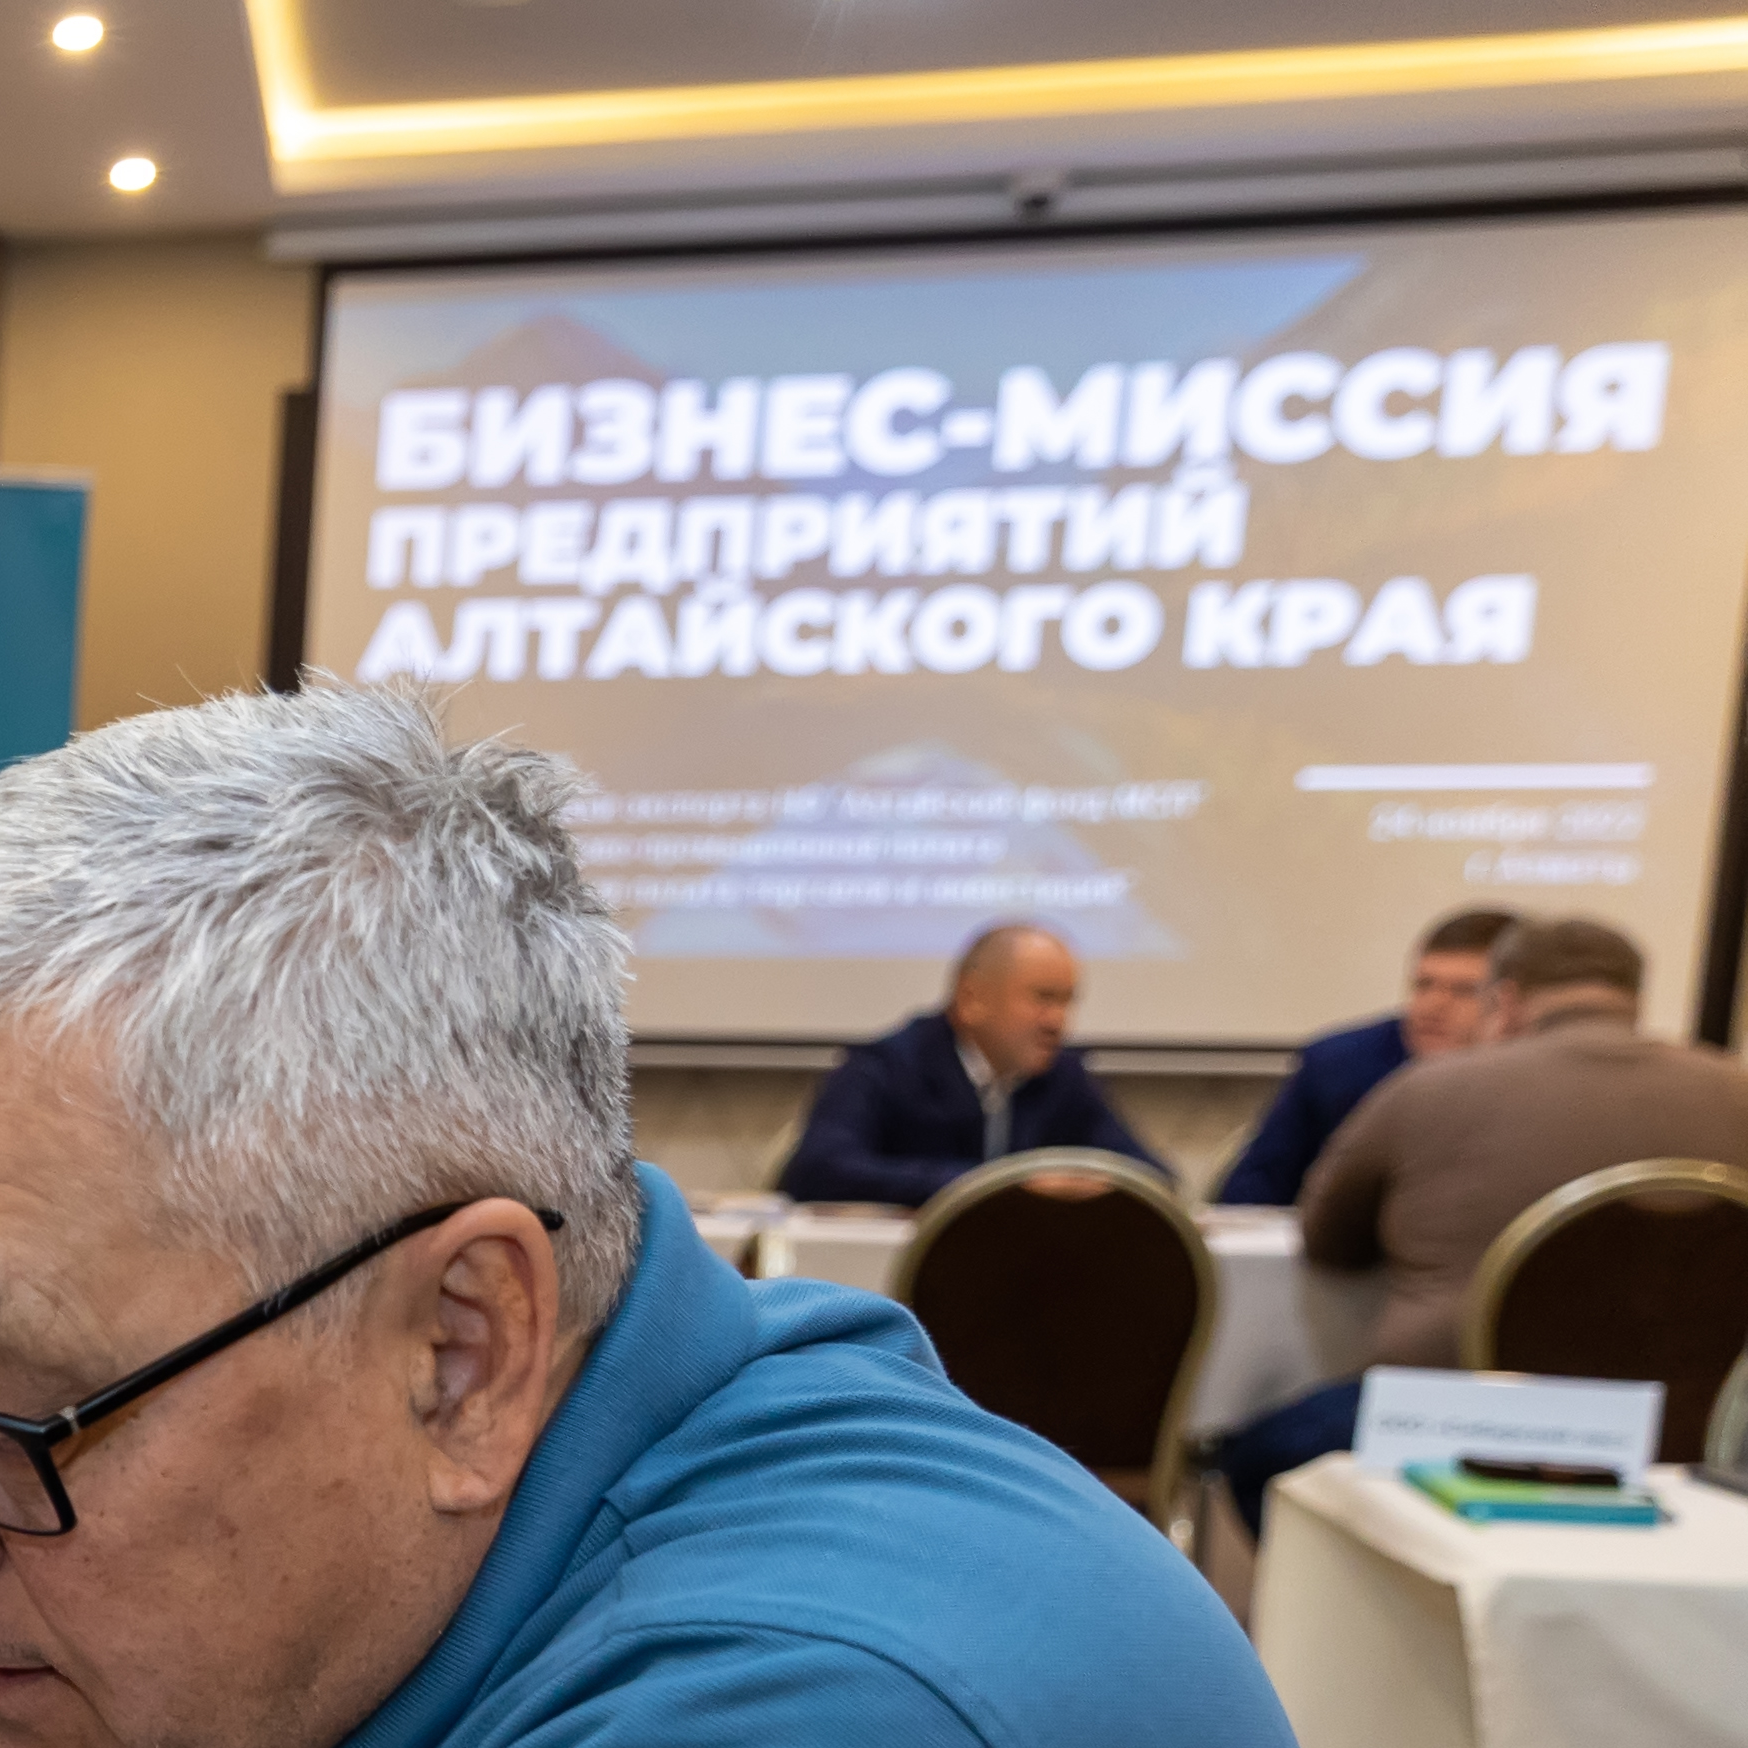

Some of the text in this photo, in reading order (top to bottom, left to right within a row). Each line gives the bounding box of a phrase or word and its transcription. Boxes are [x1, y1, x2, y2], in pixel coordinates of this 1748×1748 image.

[373, 338, 1671, 494] БИЗНЕС-МИССИЯ
[363, 460, 1251, 598] ПРЕДПРИЯТИЙ
[357, 570, 1539, 686] АЛТАЙСКОГО КРАЯ
